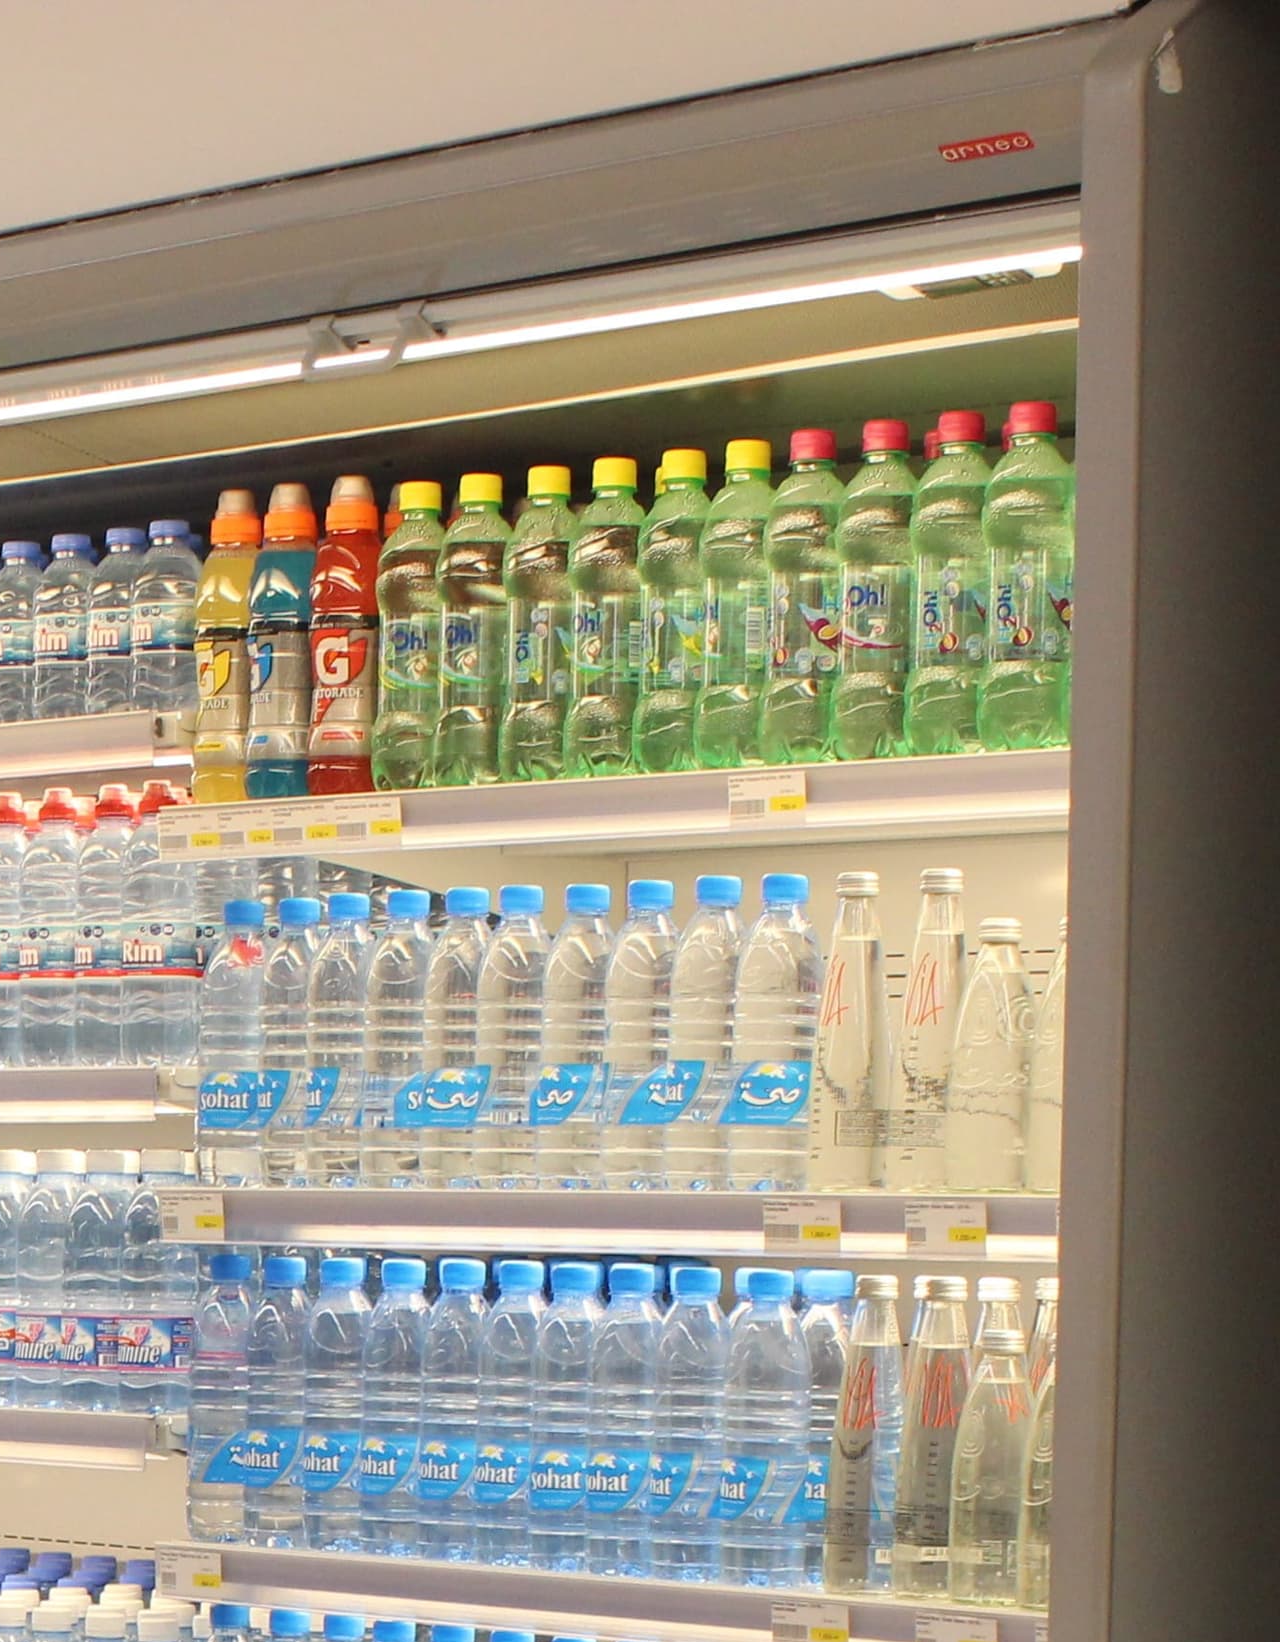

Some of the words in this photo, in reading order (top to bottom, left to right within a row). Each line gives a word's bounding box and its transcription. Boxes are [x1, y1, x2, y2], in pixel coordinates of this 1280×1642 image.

[39, 626, 69, 651] im
[91, 623, 120, 648] im
[393, 630, 429, 651] Oh!
[20, 944, 40, 966] im
[122, 937, 163, 964] Rim
[200, 1089, 250, 1111] sohat
[243, 1449, 281, 1469] ohat
[303, 1451, 341, 1474] ohat
[360, 1454, 398, 1478] ohat
[419, 1458, 459, 1481] ohat
[474, 1460, 517, 1485] ohat
[585, 1468, 630, 1494] ohat
[649, 1474, 671, 1496] hat
[720, 1476, 746, 1501] hat
